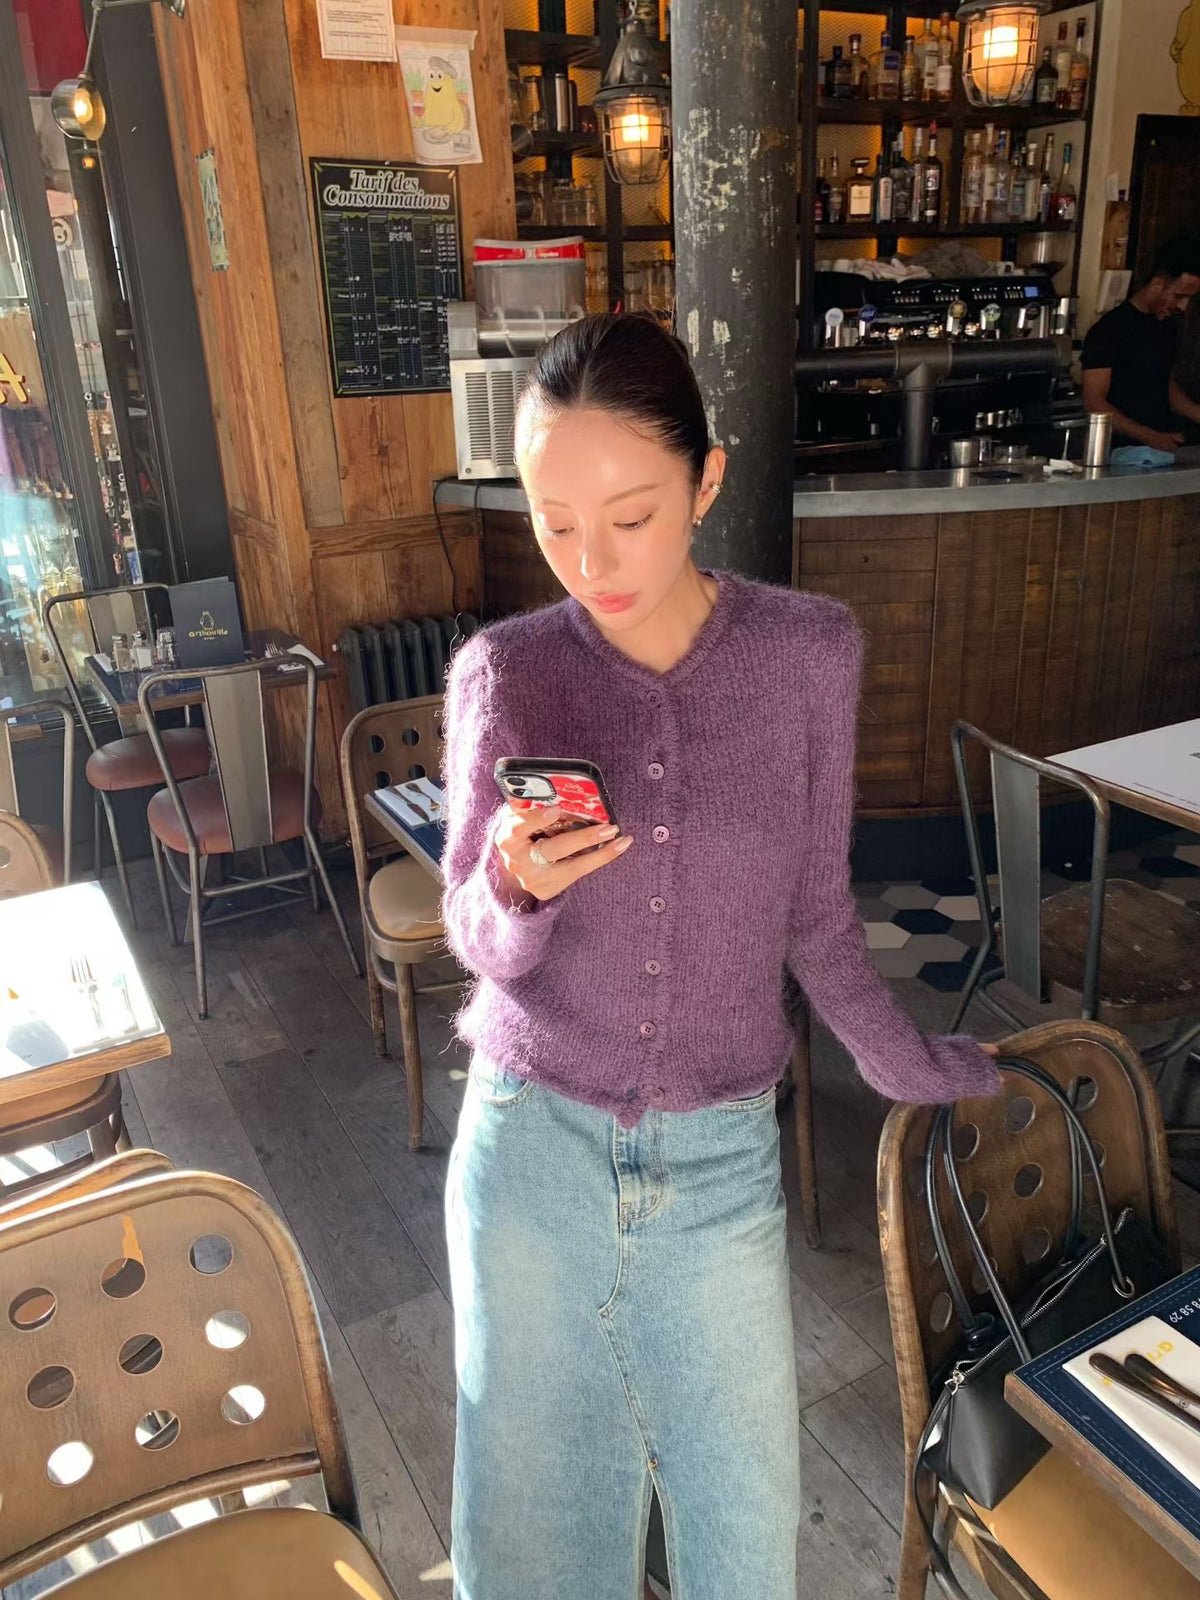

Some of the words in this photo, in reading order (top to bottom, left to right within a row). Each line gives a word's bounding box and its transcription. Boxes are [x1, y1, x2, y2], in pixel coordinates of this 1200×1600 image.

[350, 169, 393, 193] Tarif
[391, 171, 419, 192] des
[323, 184, 450, 210] Consommations
[1169, 1311, 1183, 1323] 29
[1180, 1304, 1194, 1316] 58
